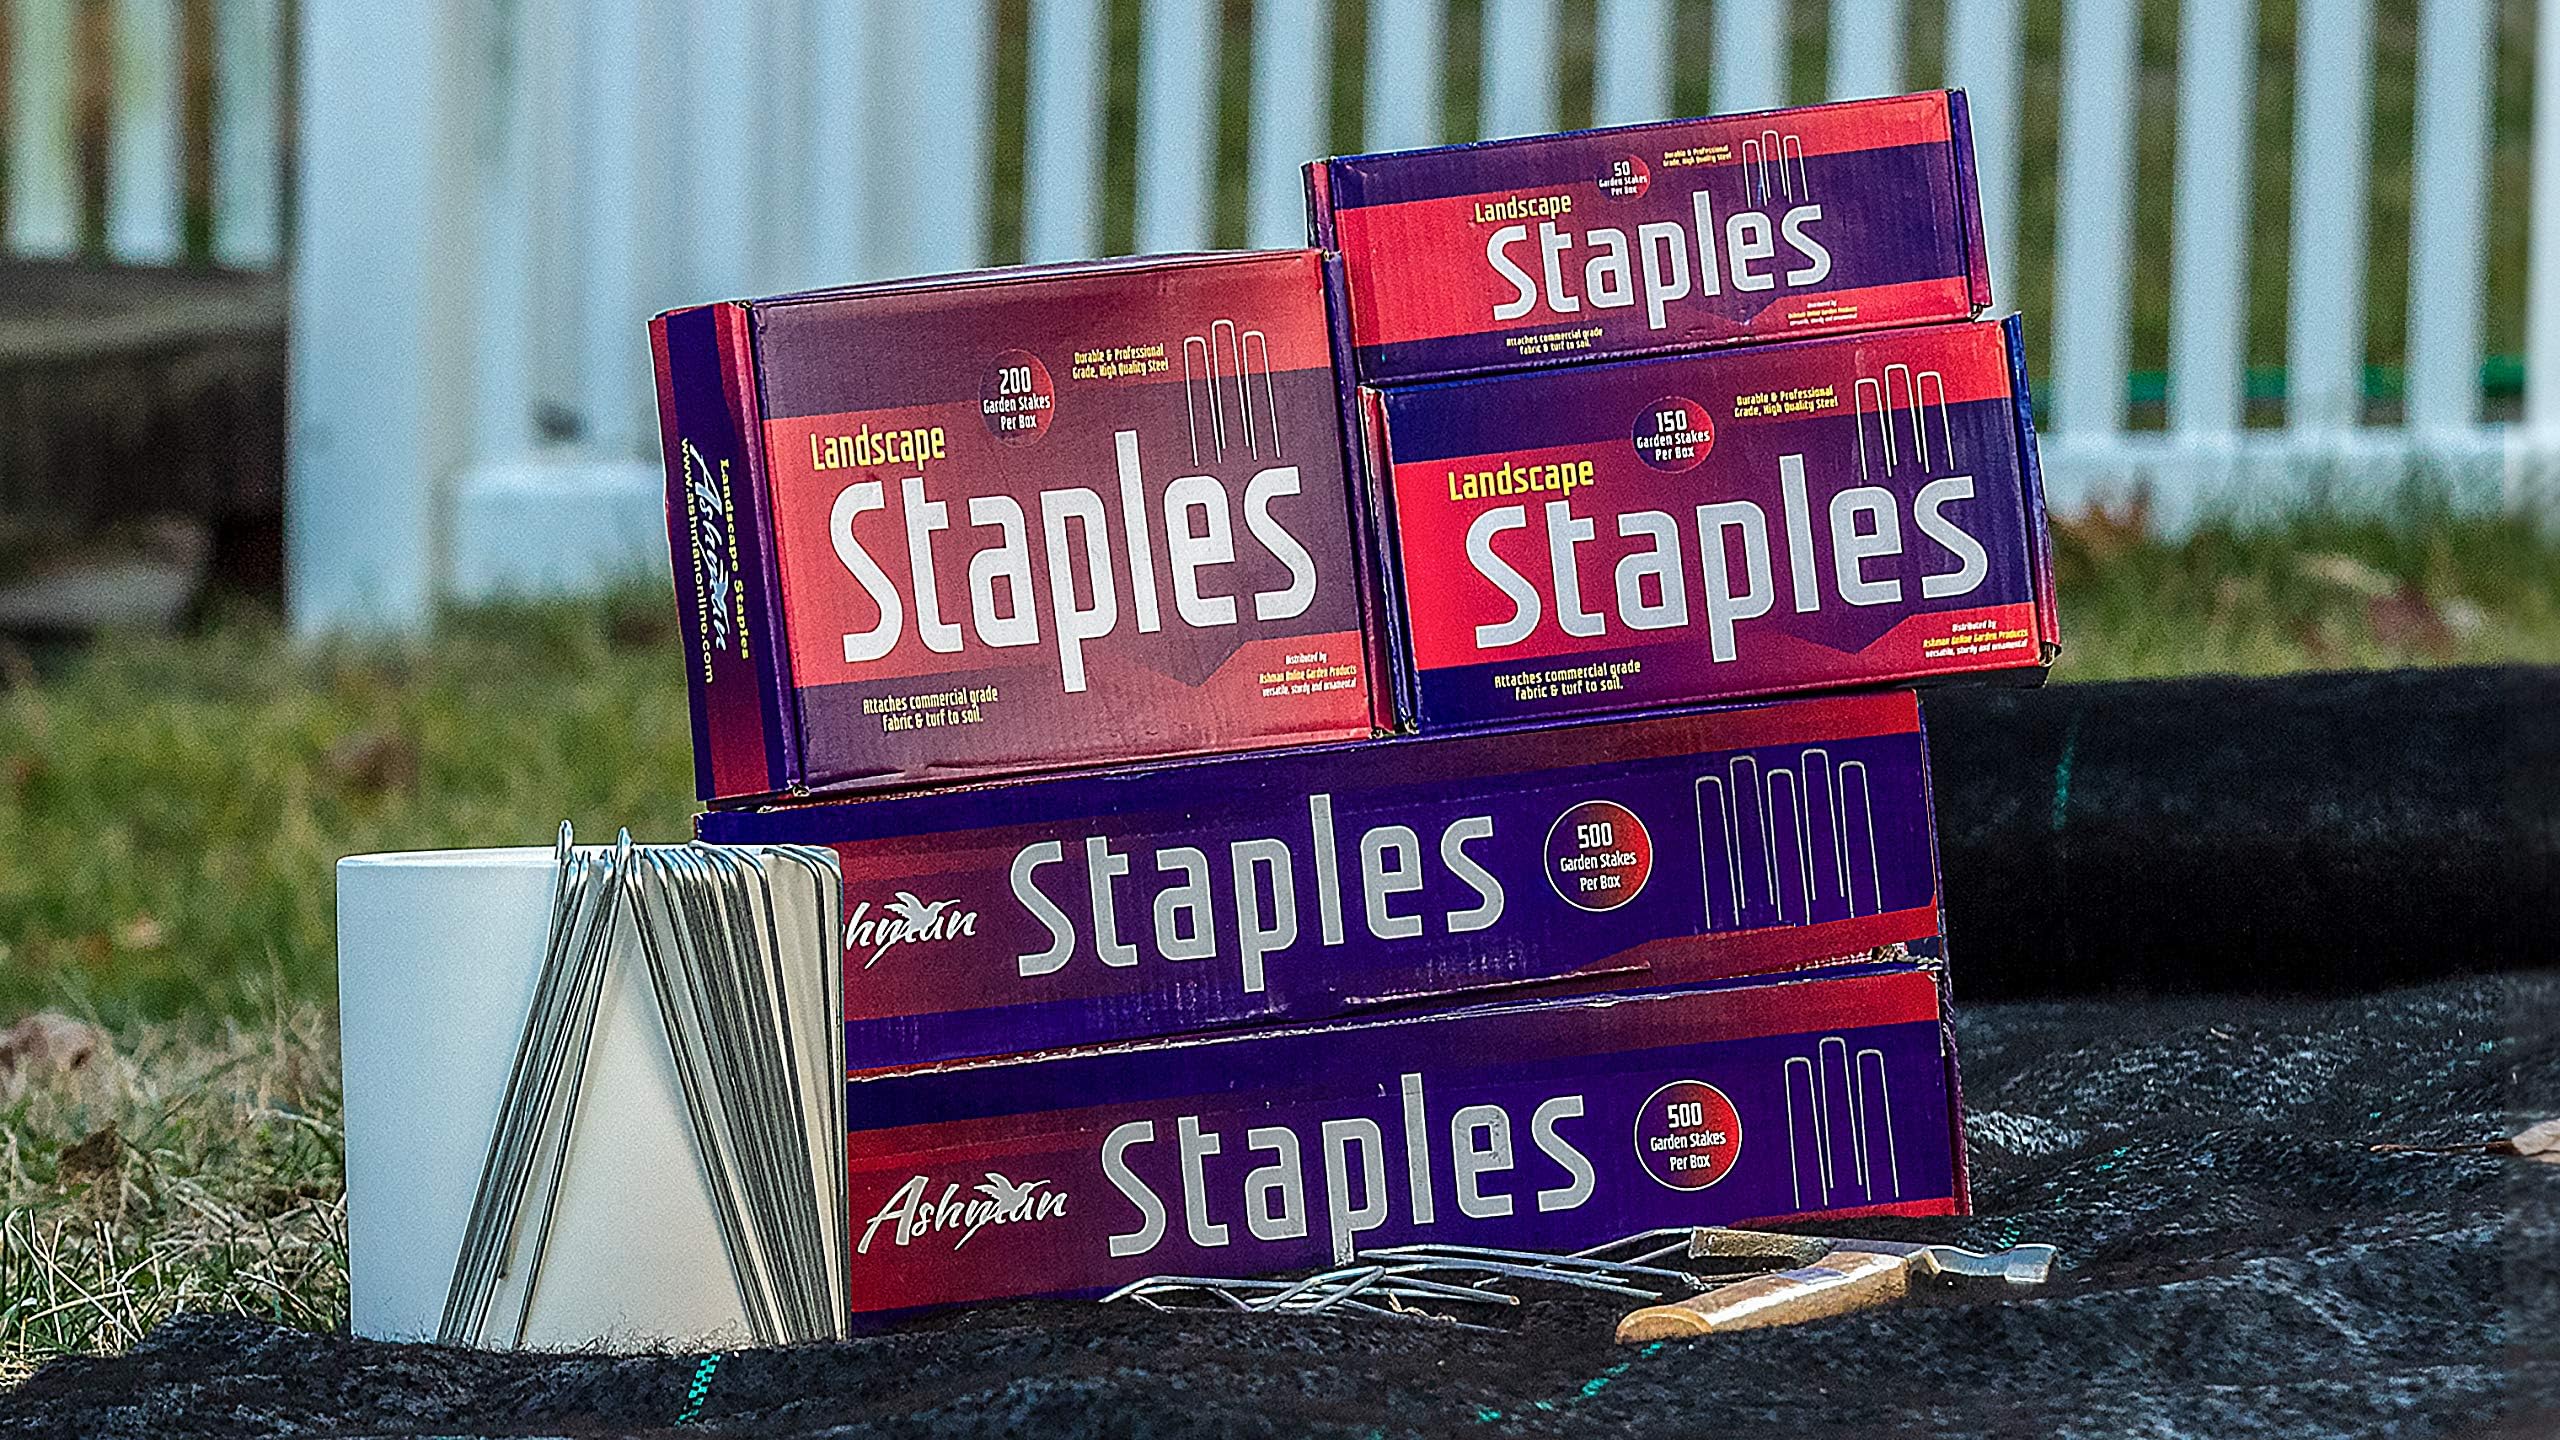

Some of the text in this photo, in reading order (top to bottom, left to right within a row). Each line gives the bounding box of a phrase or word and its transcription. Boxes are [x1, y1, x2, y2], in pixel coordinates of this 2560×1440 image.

[1599, 174, 1647, 187] Garden Stakes
[1614, 161, 1630, 176] 50
[1611, 186, 1637, 196] Per Box
[1475, 195, 1571, 222] Landscape
[1486, 190, 1832, 329] Staples
[1074, 343, 1164, 365] Durable & Professional
[999, 366, 1032, 395] 200
[1072, 357, 1169, 380] Grade, High Quality Steel
[983, 393, 1051, 414] Garden Stakes
[1734, 395, 1838, 418] Grade, High Quality Steel
[1736, 384, 1833, 406] Durable & Professional
[1000, 414, 1037, 431] Per Box
[1656, 409, 1687, 433] 150
[810, 424, 945, 471] Landscape
[1636, 429, 1710, 449] Garden Stakes
[1655, 445, 1694, 461] Per Box
[1449, 459, 1594, 501] Landscape
[720, 459, 749, 659] Landscape Staples
[829, 430, 1317, 693] Staples
[1465, 453, 1989, 664] Staples
[1494, 659, 1641, 689] Attaches commercial grade
[863, 684, 999, 715] Attaches commercial grade
[1515, 676, 1623, 701] fabric & turf to soil.
[883, 705, 983, 732] fabric & turf to soil.
[1577, 822, 1613, 849] 500
[1560, 850, 1637, 872] Garden Stakes
[1009, 792, 1505, 993] Staples
[1580, 875, 1621, 892] Per Box
[1667, 1102, 1703, 1128] 500
[1650, 1129, 1727, 1152] Garden Stakes
[1101, 1073, 1594, 1267] Staples
[1670, 1154, 1711, 1172] Per Box
[857, 1175, 1067, 1254] Ashman
